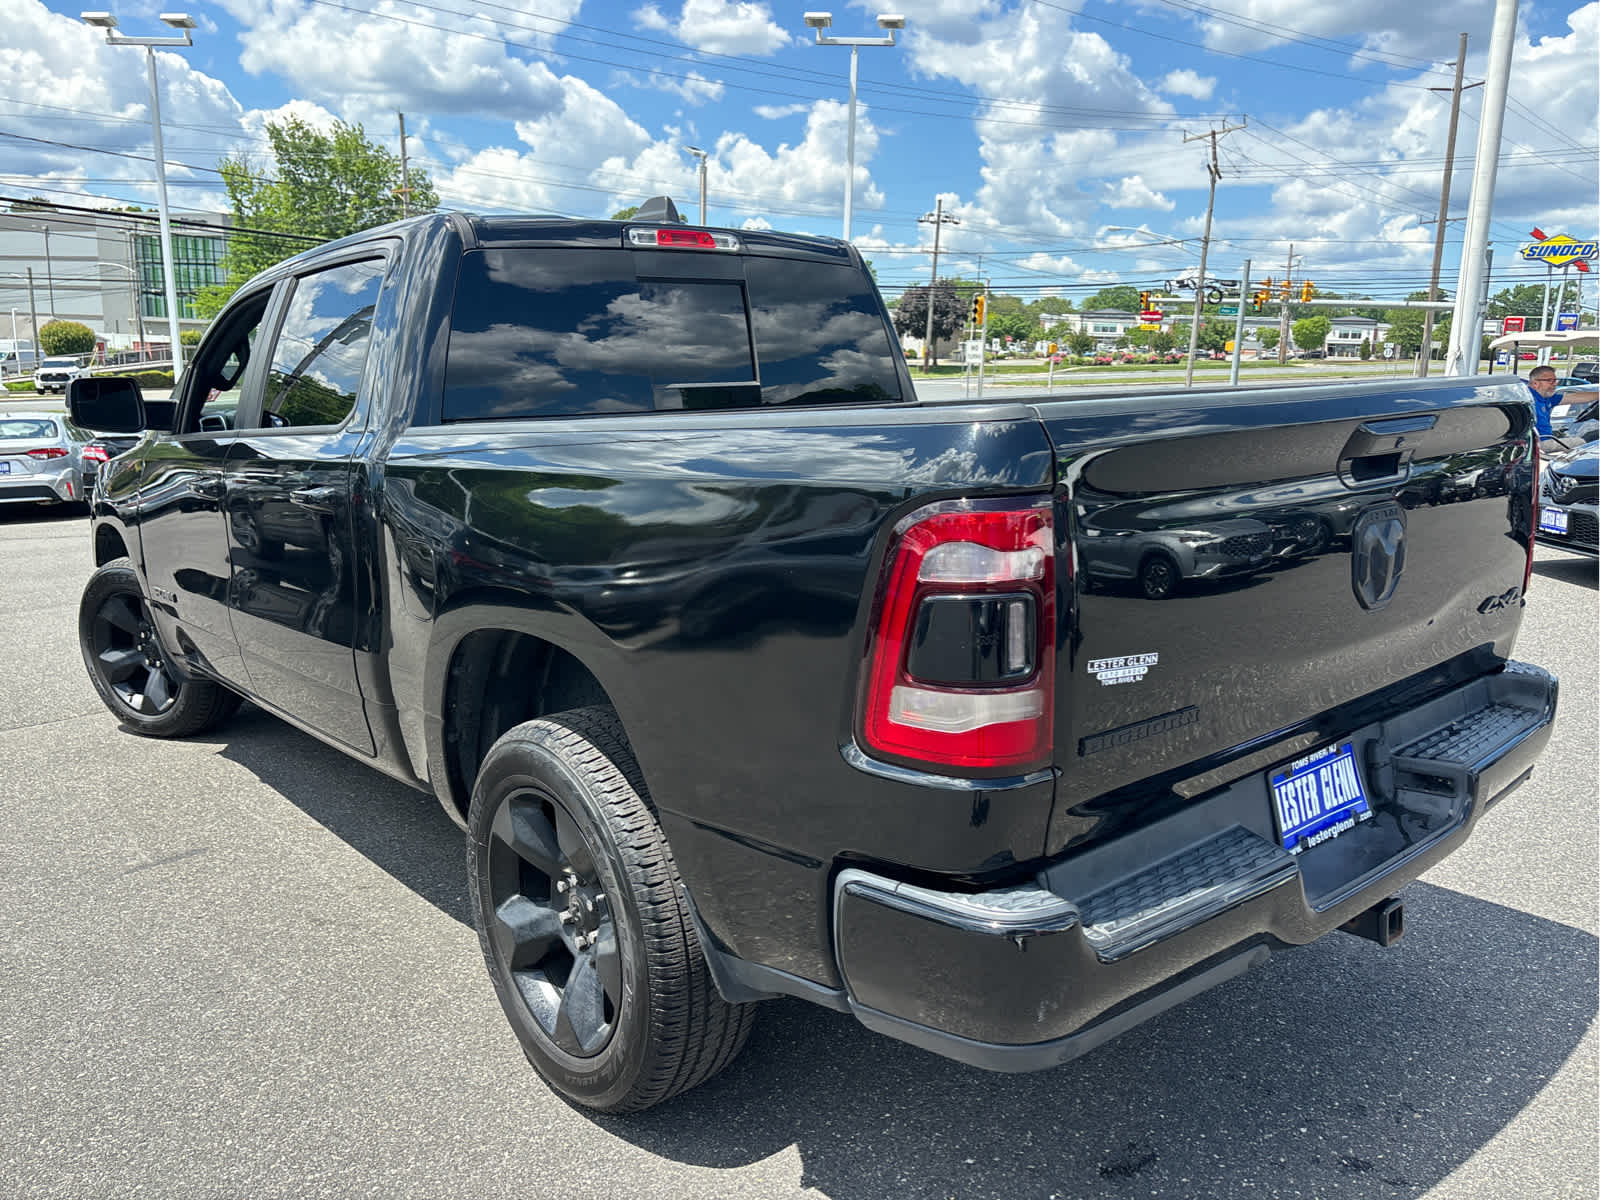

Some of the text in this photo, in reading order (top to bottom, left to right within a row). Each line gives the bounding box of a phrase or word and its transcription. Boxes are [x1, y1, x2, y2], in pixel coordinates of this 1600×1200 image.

[1526, 244, 1594, 257] SUNOCO
[1087, 654, 1159, 671] LESTER GLENN
[1291, 756, 1309, 771] TOMS
[1328, 743, 1337, 753] NJ
[1274, 755, 1361, 833] LESTER GLENN
[1307, 818, 1355, 848] lesterglenn
